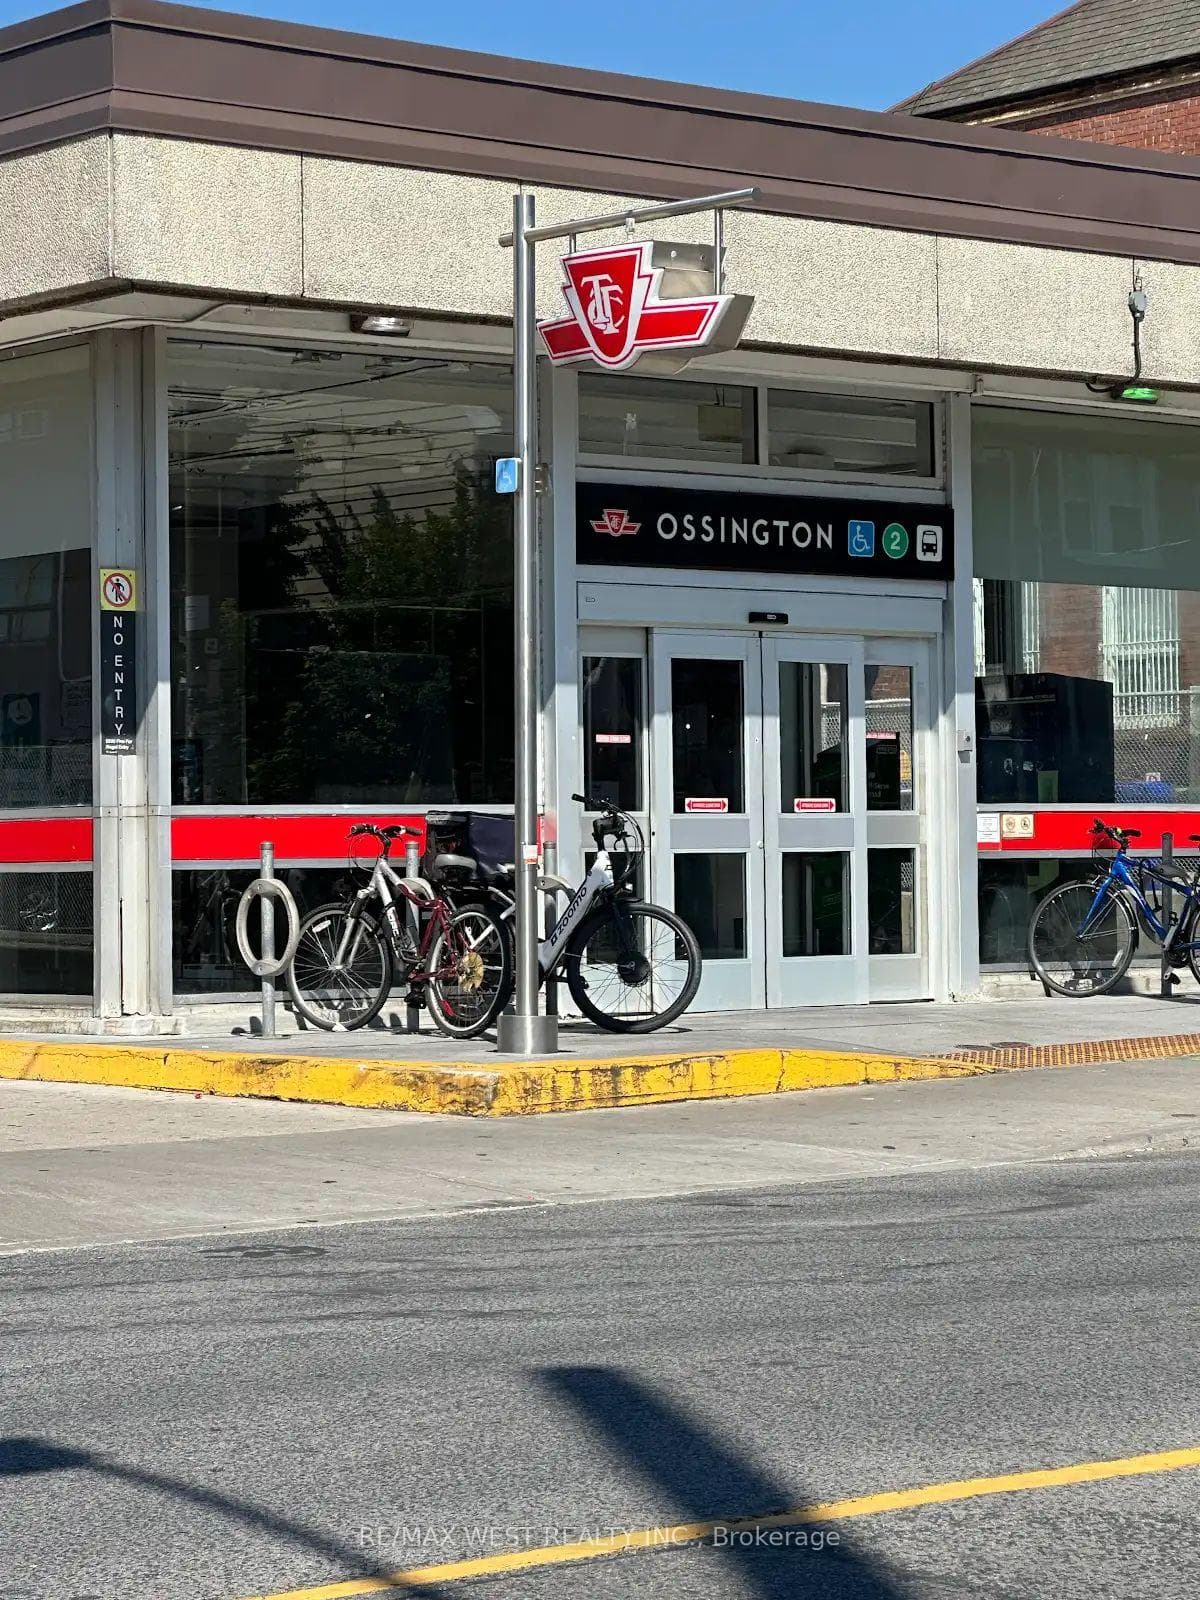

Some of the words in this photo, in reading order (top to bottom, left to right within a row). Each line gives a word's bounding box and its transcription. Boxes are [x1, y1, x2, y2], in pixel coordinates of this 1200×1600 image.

[581, 274, 625, 334] TTC
[656, 512, 833, 550] OSSINGTON
[890, 531, 901, 550] 2
[113, 615, 123, 645] NO
[114, 655, 124, 735] ENTRY
